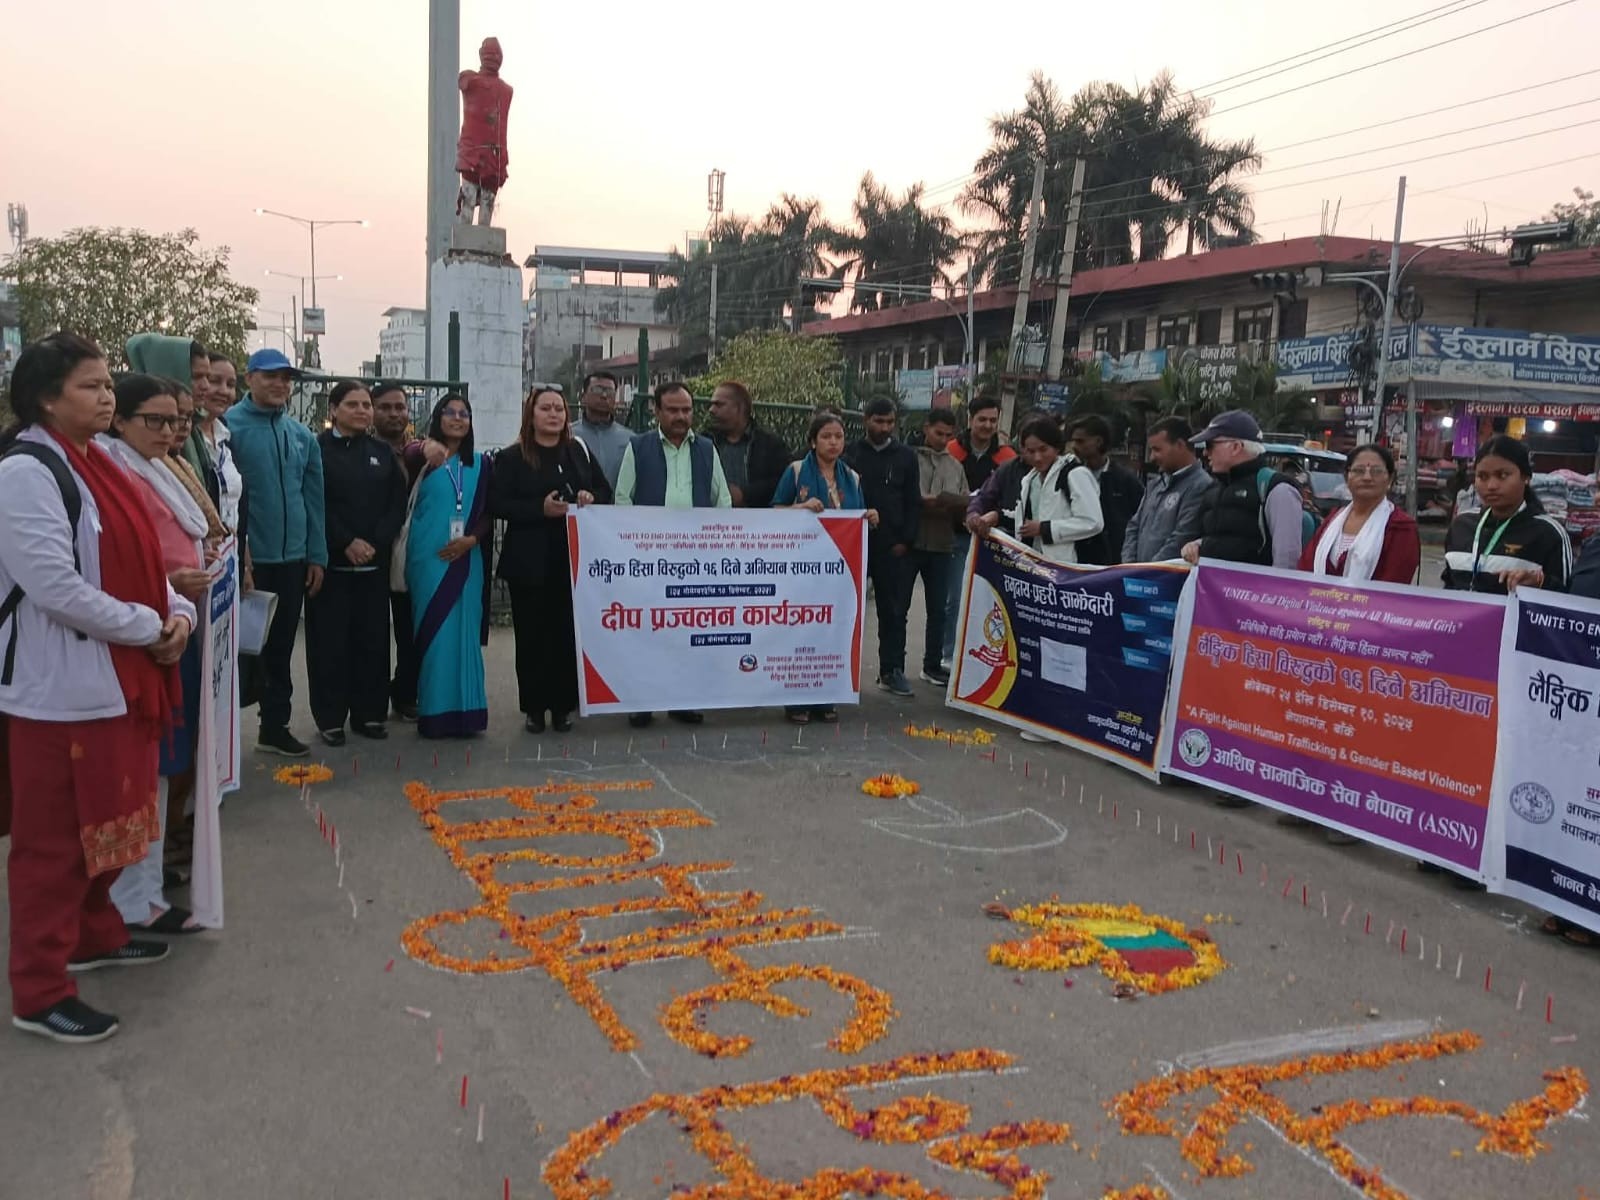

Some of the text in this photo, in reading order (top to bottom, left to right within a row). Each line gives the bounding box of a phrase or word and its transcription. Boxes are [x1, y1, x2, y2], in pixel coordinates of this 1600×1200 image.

[703, 562, 718, 578] १६
[721, 558, 741, 577] दिने
[744, 557, 787, 575] अभियान
[790, 561, 821, 575] सफल
[601, 599, 834, 631] दीप प्रज्वलन कार्यक्रम
[1260, 593, 1277, 604] End
[1278, 595, 1304, 610] Digital
[1305, 599, 1337, 615] Violence
[1383, 611, 1413, 627] Women
[1414, 618, 1432, 631] and
[1526, 609, 1566, 630] "UNITE
[1569, 619, 1585, 633] TO
[1340, 667, 1364, 693] १६
[1368, 666, 1406, 699] दिने
[1409, 677, 1494, 718] अभियान
[1199, 708, 1220, 724] Fight
[1221, 715, 1252, 733] Against
[1253, 724, 1285, 744] Human
[1288, 732, 1336, 761] Trafficking
[1338, 747, 1348, 760] &
[1350, 750, 1389, 771] Gender
[1392, 761, 1426, 782] Based
[1429, 771, 1483, 797] Violence"
[1213, 748, 1479, 850] आशिष सामाजिक सेवा नेपाल (ASSN)
